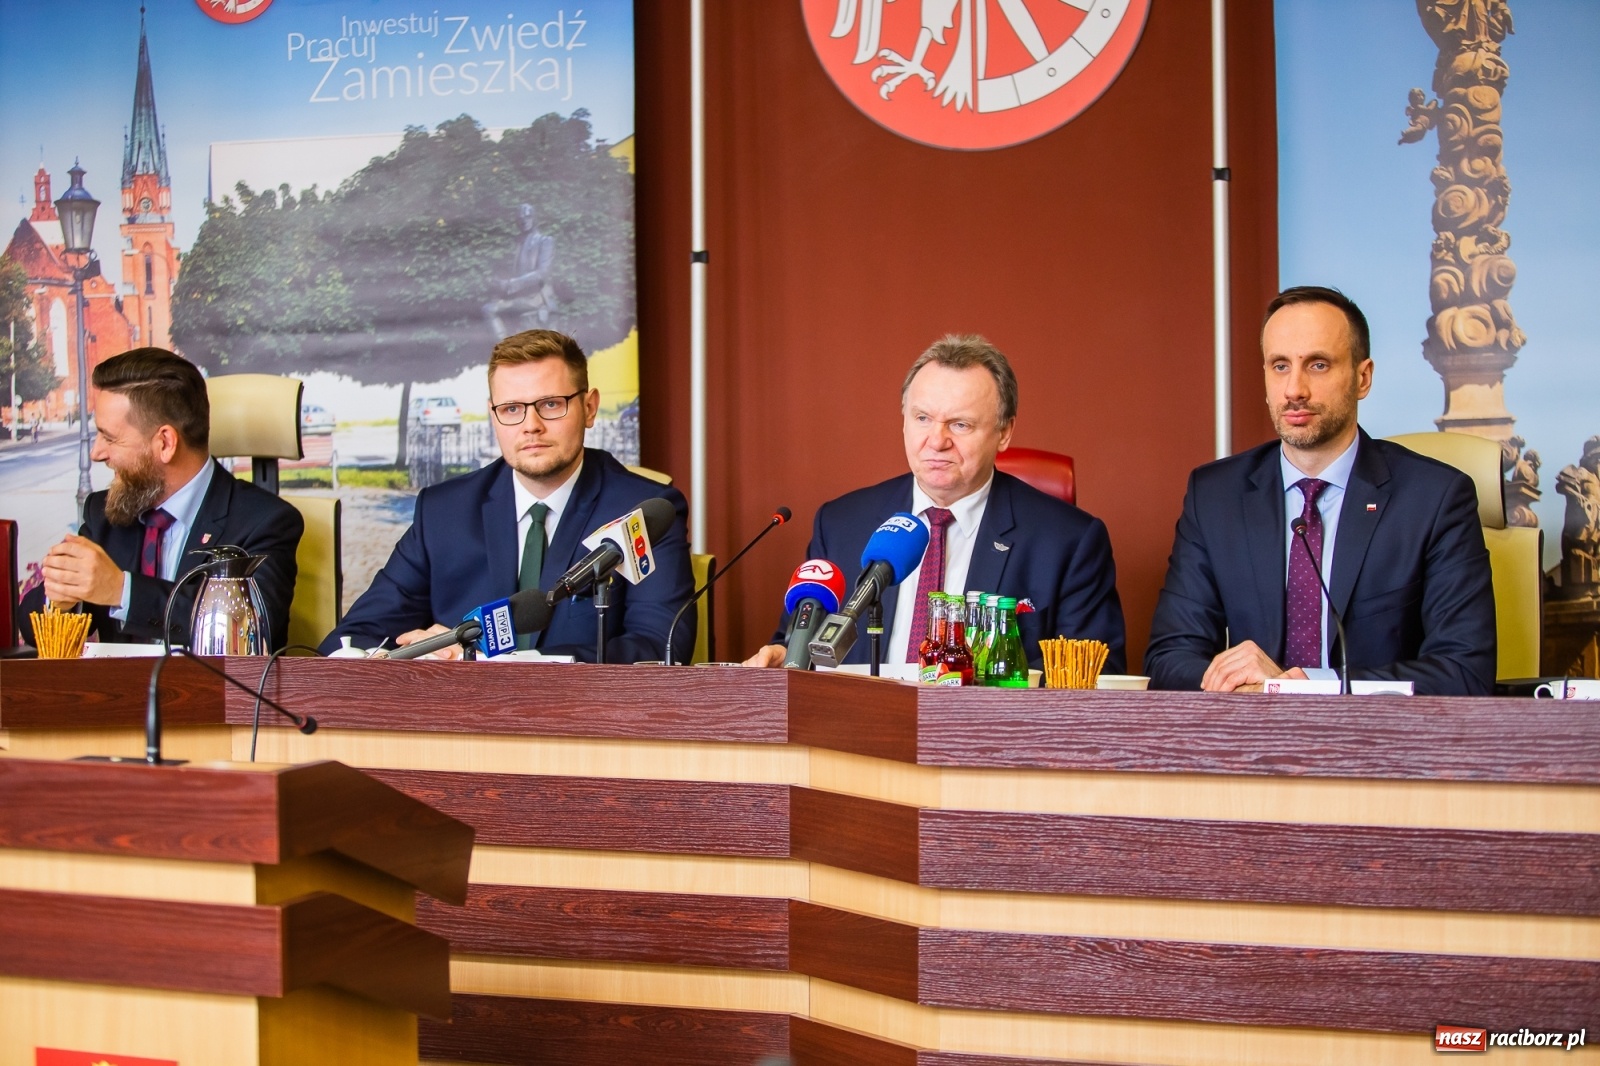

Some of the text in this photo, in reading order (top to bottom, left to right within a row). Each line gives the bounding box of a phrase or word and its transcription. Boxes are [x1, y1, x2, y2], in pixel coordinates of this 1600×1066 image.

[342, 10, 438, 38] Inwestuj
[443, 9, 587, 54] Zwiedź
[287, 27, 376, 63] Pracuj
[309, 45, 573, 103] Zamieszkaj
[631, 521, 648, 569] RTK
[484, 613, 496, 651] KATOWICE
